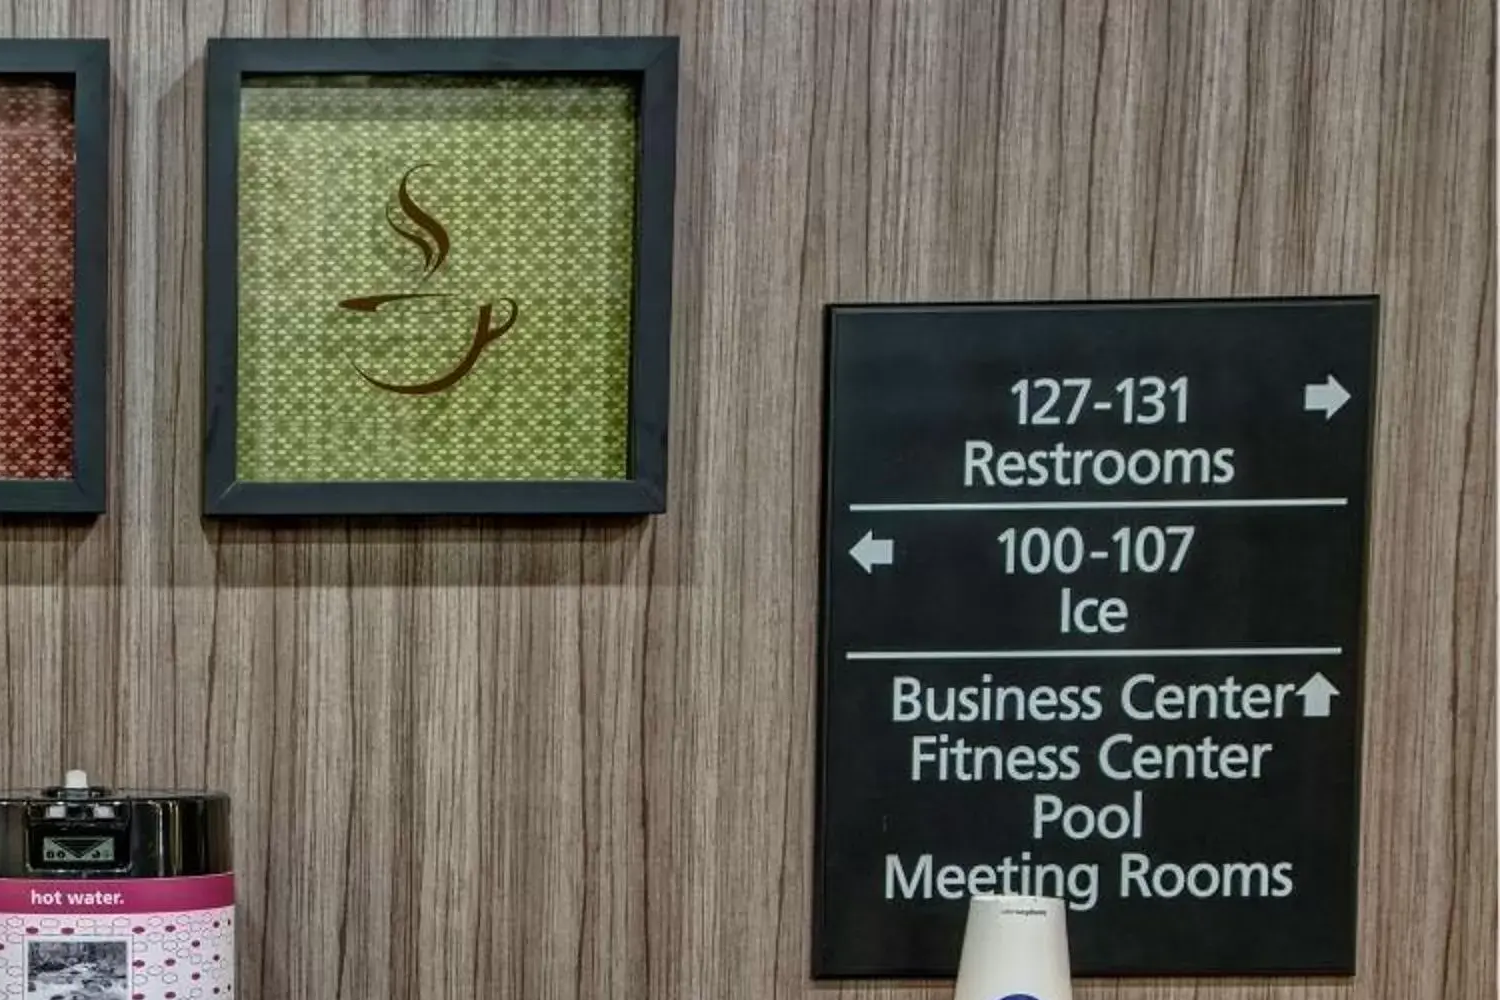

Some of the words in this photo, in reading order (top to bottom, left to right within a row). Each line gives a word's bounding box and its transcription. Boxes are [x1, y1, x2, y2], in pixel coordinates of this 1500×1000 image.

[1011, 376, 1188, 425] 127-131
[963, 440, 1235, 487] Restrooms
[997, 525, 1195, 574] 100-107
[1060, 587, 1129, 634] Ice
[892, 673, 1103, 722] Business
[1121, 673, 1294, 721] Center
[911, 733, 1081, 781] Fitness
[1098, 733, 1273, 780] Center
[1033, 790, 1143, 840] Pool
[31, 888, 62, 905] hot
[67, 890, 125, 905] water.
[885, 851, 1099, 911] Meeting
[1120, 853, 1293, 898] Rooms
